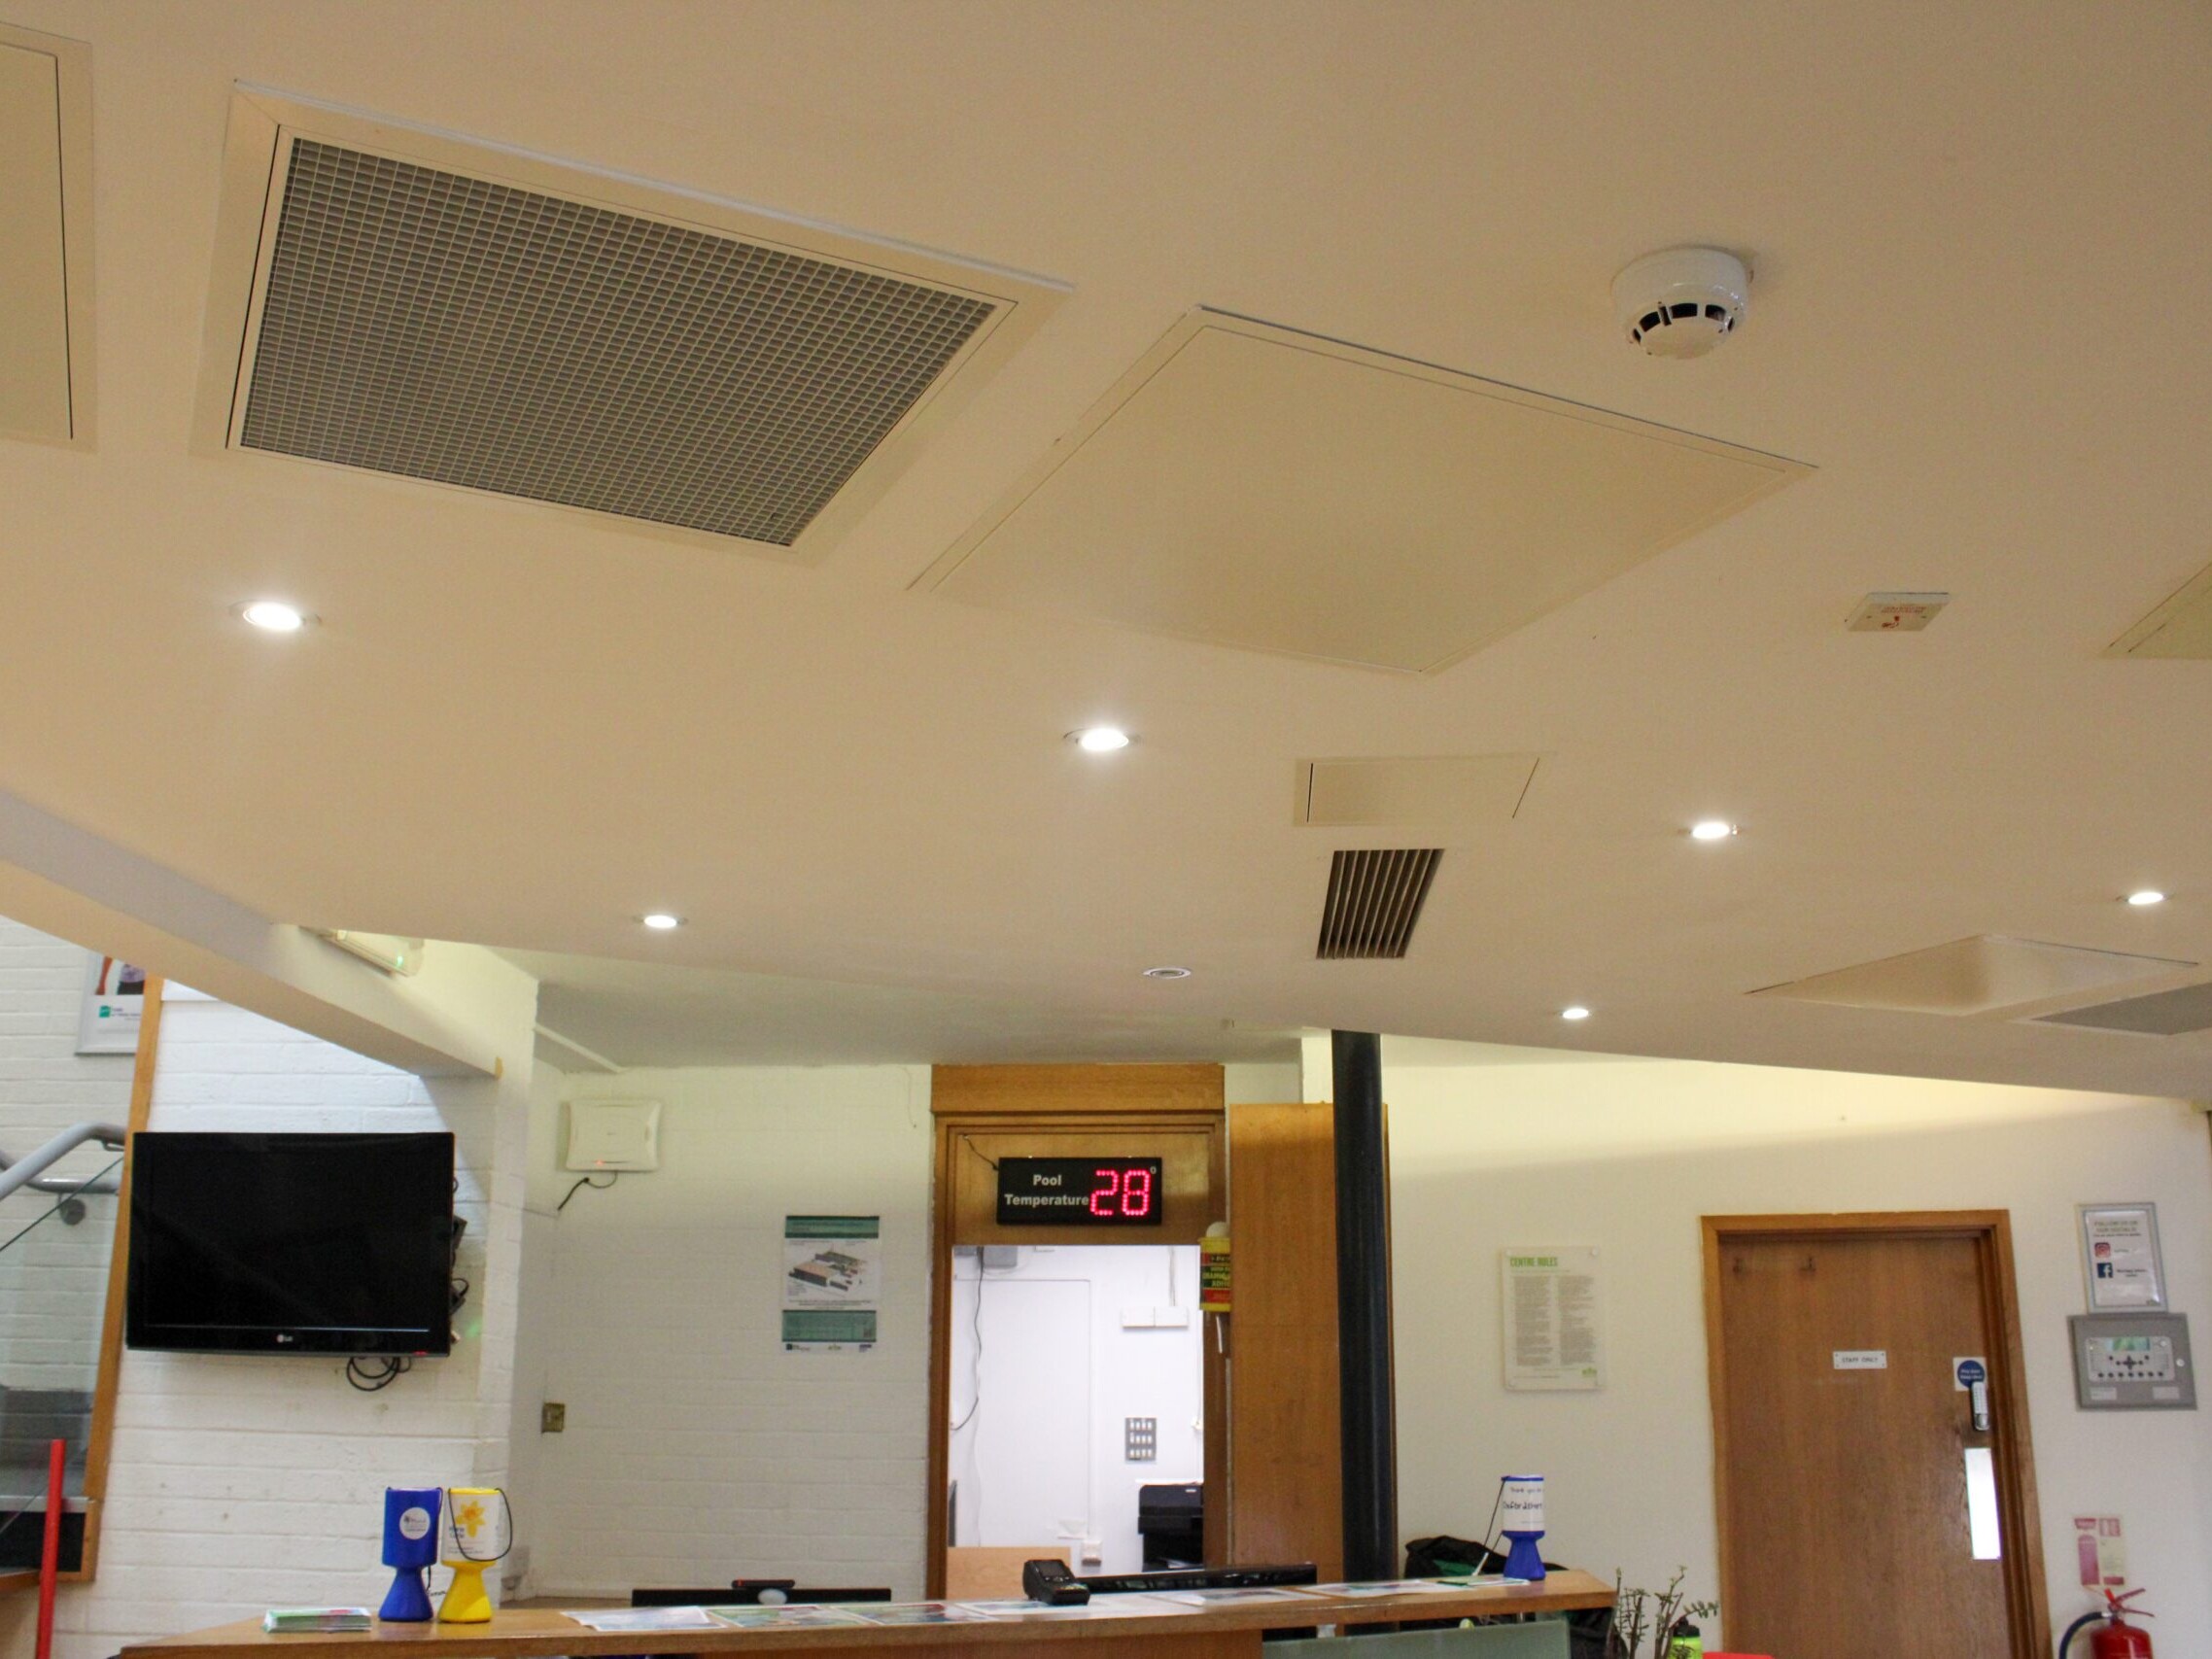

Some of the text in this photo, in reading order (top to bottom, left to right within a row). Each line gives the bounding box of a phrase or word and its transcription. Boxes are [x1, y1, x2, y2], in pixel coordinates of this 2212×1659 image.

[1032, 1174, 1062, 1186] Pool
[1089, 1169, 1152, 1217] 28
[1004, 1193, 1089, 1208] Temperature
[1509, 1257, 1558, 1267] CENTRE RULES
